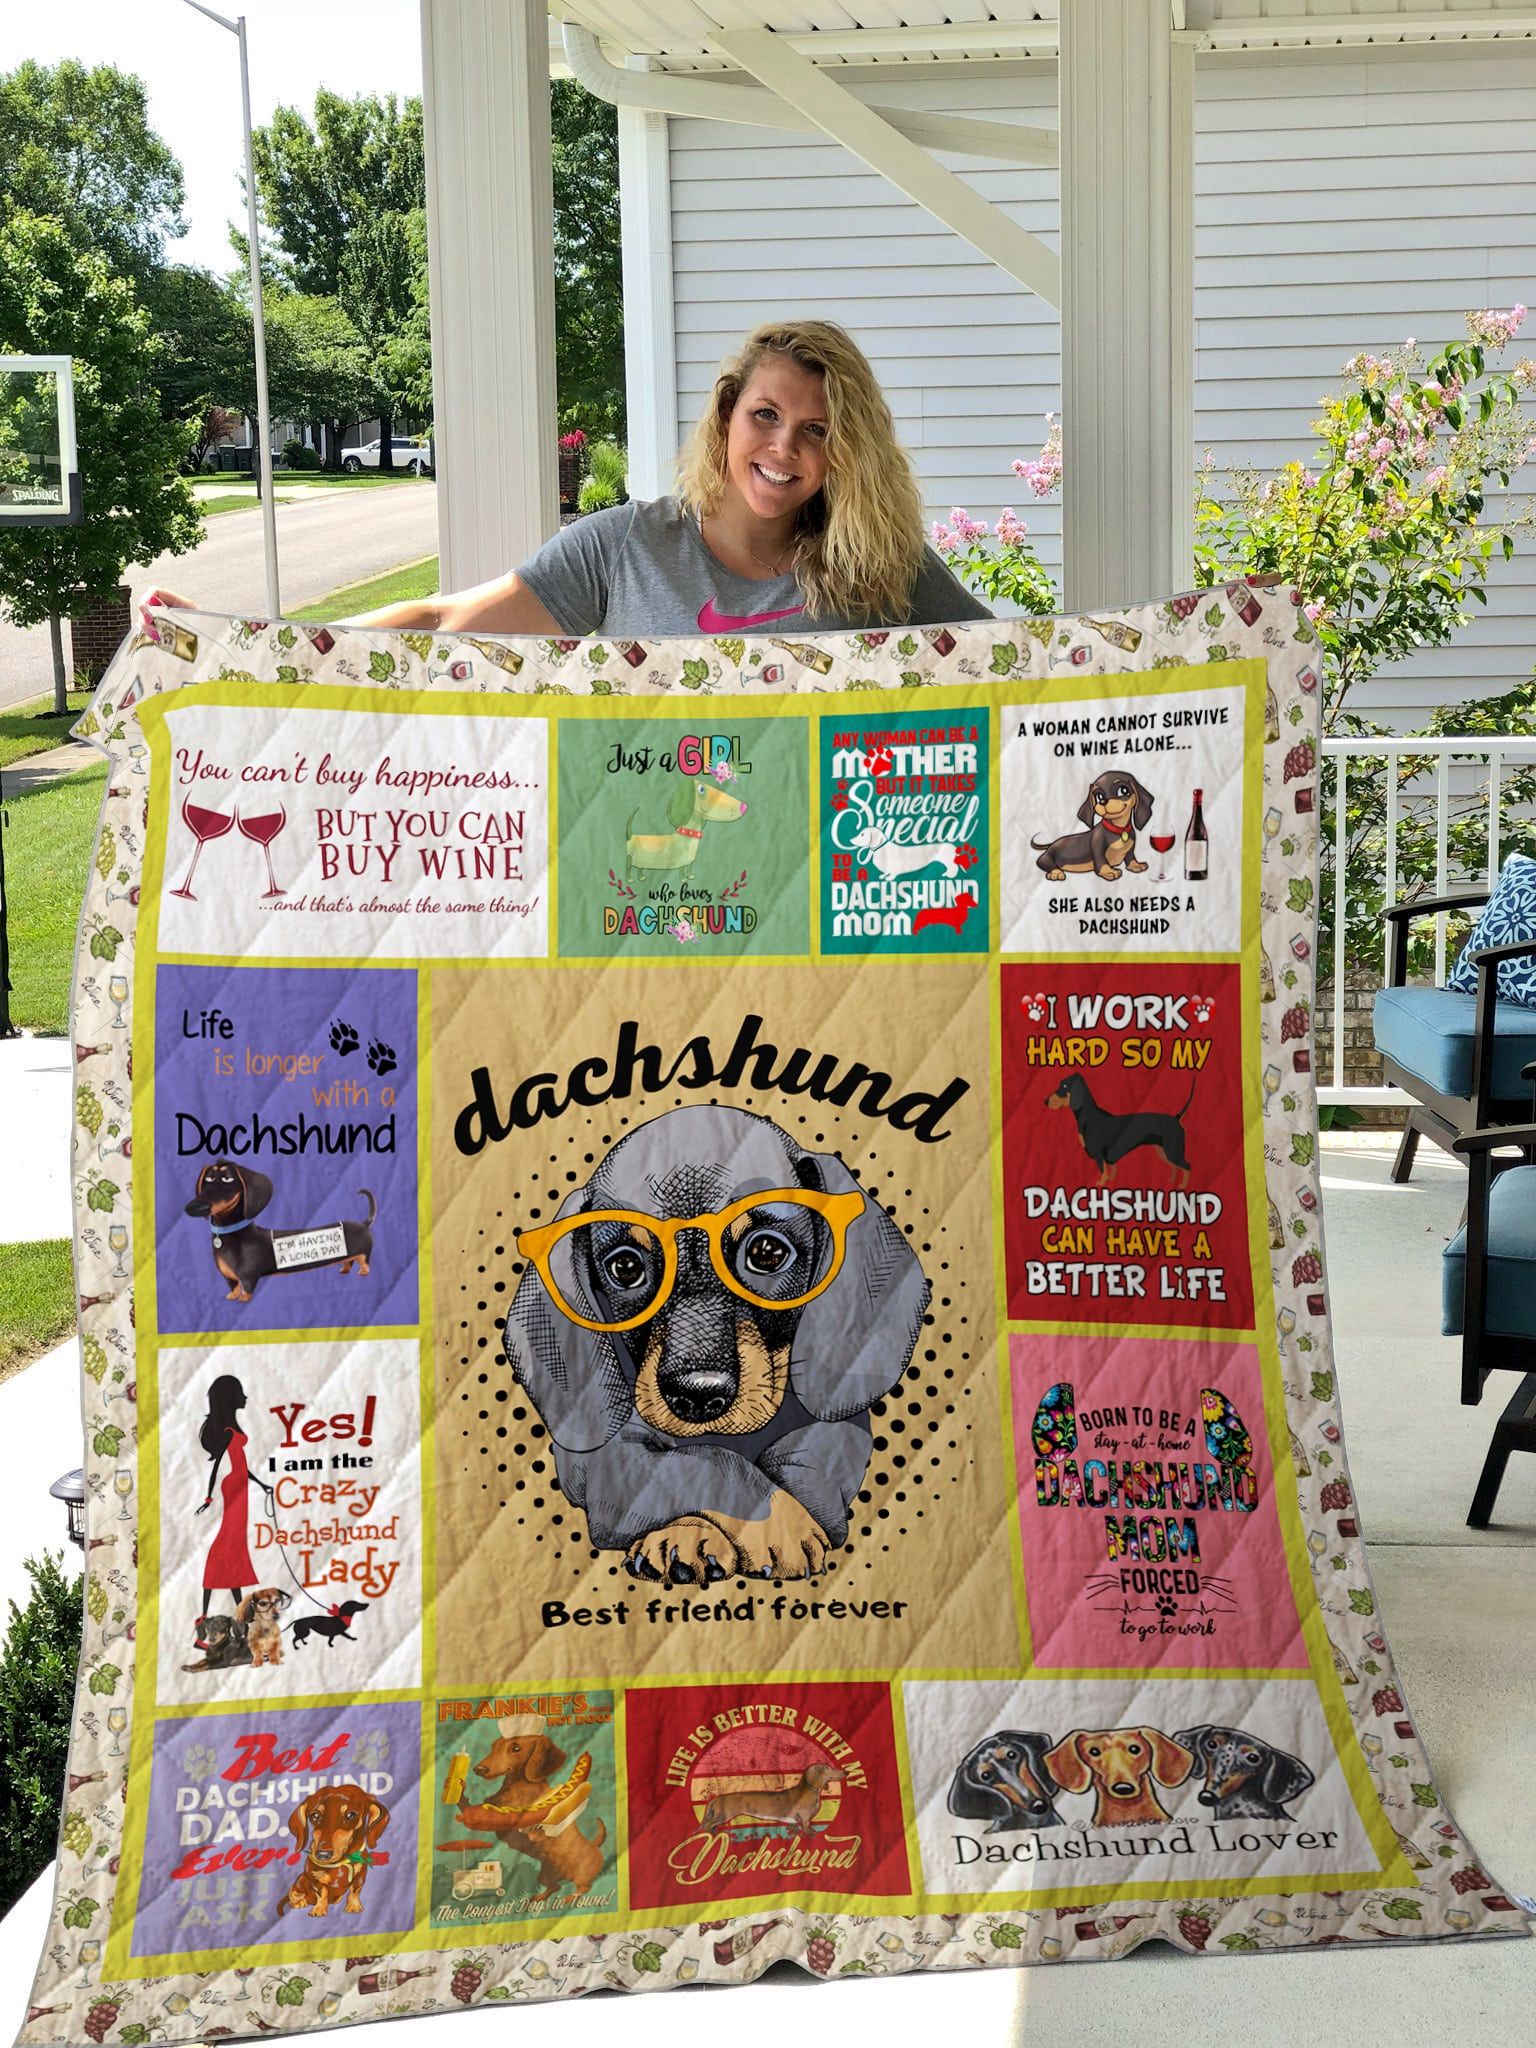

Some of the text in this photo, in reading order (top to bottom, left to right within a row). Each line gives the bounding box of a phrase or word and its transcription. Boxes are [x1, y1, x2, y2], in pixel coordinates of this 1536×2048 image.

[12, 489, 61, 502] SPALDING
[1262, 626, 1288, 649] Wine
[648, 670, 674, 691] Wine
[957, 658, 984, 679] Wine
[832, 726, 979, 749] ANY WOMAN CAN BE A
[1018, 707, 1229, 737] A WOMAN CANNOT SURVIVE
[607, 734, 752, 776] Just a GIRL
[1054, 735, 1192, 757] ON WINE ALONE...
[175, 748, 539, 796] You can't buy happiness...
[876, 774, 976, 795] BUT IT TAKES
[315, 808, 525, 844] BUT YOU CAN
[320, 843, 523, 882] BUY WINE
[831, 854, 853, 868] TO
[832, 867, 868, 882] BE A
[310, 896, 353, 913] that's
[359, 896, 412, 914] almost
[415, 897, 442, 914] the
[444, 900, 485, 914] same
[489, 897, 538, 918] thing!
[648, 882, 713, 903] who loves
[831, 879, 979, 911] DACHSHUND
[1049, 896, 1196, 913] SHE ALSO NEEDS A
[603, 905, 758, 936] DACHSHUND
[1079, 919, 1170, 935] DACHSHUND
[182, 1009, 234, 1040] Life
[1047, 994, 1190, 1031] I WORK
[214, 1048, 325, 1082] is longer
[1026, 1036, 1212, 1070] HARD SO MY
[311, 1080, 396, 1108] with a
[453, 1014, 971, 1156] dachshund
[175, 1112, 397, 1156] Dachshund
[1023, 1186, 1222, 1225] DACHSHUND
[277, 1231, 342, 1251] I'M HAVING
[279, 1244, 341, 1265] A LONG DAY
[1041, 1225, 1213, 1260] CAN HAVE A
[1025, 1260, 1147, 1298] BETTER
[105, 1327, 129, 1356] Wine
[270, 1395, 377, 1449] Yes!
[1079, 1406, 1196, 1437] BORN TO BE A
[268, 1453, 373, 1472] I am the
[275, 1476, 381, 1517] Crazy
[1034, 1458, 1260, 1513] DACHSHUND
[254, 1515, 400, 1549] Dachshund
[1104, 1515, 1201, 1563] MOM
[107, 1569, 130, 1596] Wine
[299, 1546, 400, 1598] Lady
[1119, 1568, 1200, 1595] FORCED
[541, 1597, 908, 1628] Best friend forever
[1120, 1615, 1216, 1642] to go to work
[438, 1694, 589, 1723] FRANKIE'S
[547, 1714, 572, 1729] HOT
[220, 1733, 351, 1783] Best
[665, 1704, 868, 1790] LIFE IS BETTER WITH MY
[93, 1804, 115, 1831] Wine
[667, 1831, 862, 1885] Dachshund
[953, 1824, 1339, 1865] Dachshund Lover
[176, 1873, 277, 1906] JUST
[436, 1888, 616, 1922] The Longest Dogs in Town!
[177, 1899, 271, 1929] ASK
[556, 1953, 587, 1969] Wine
